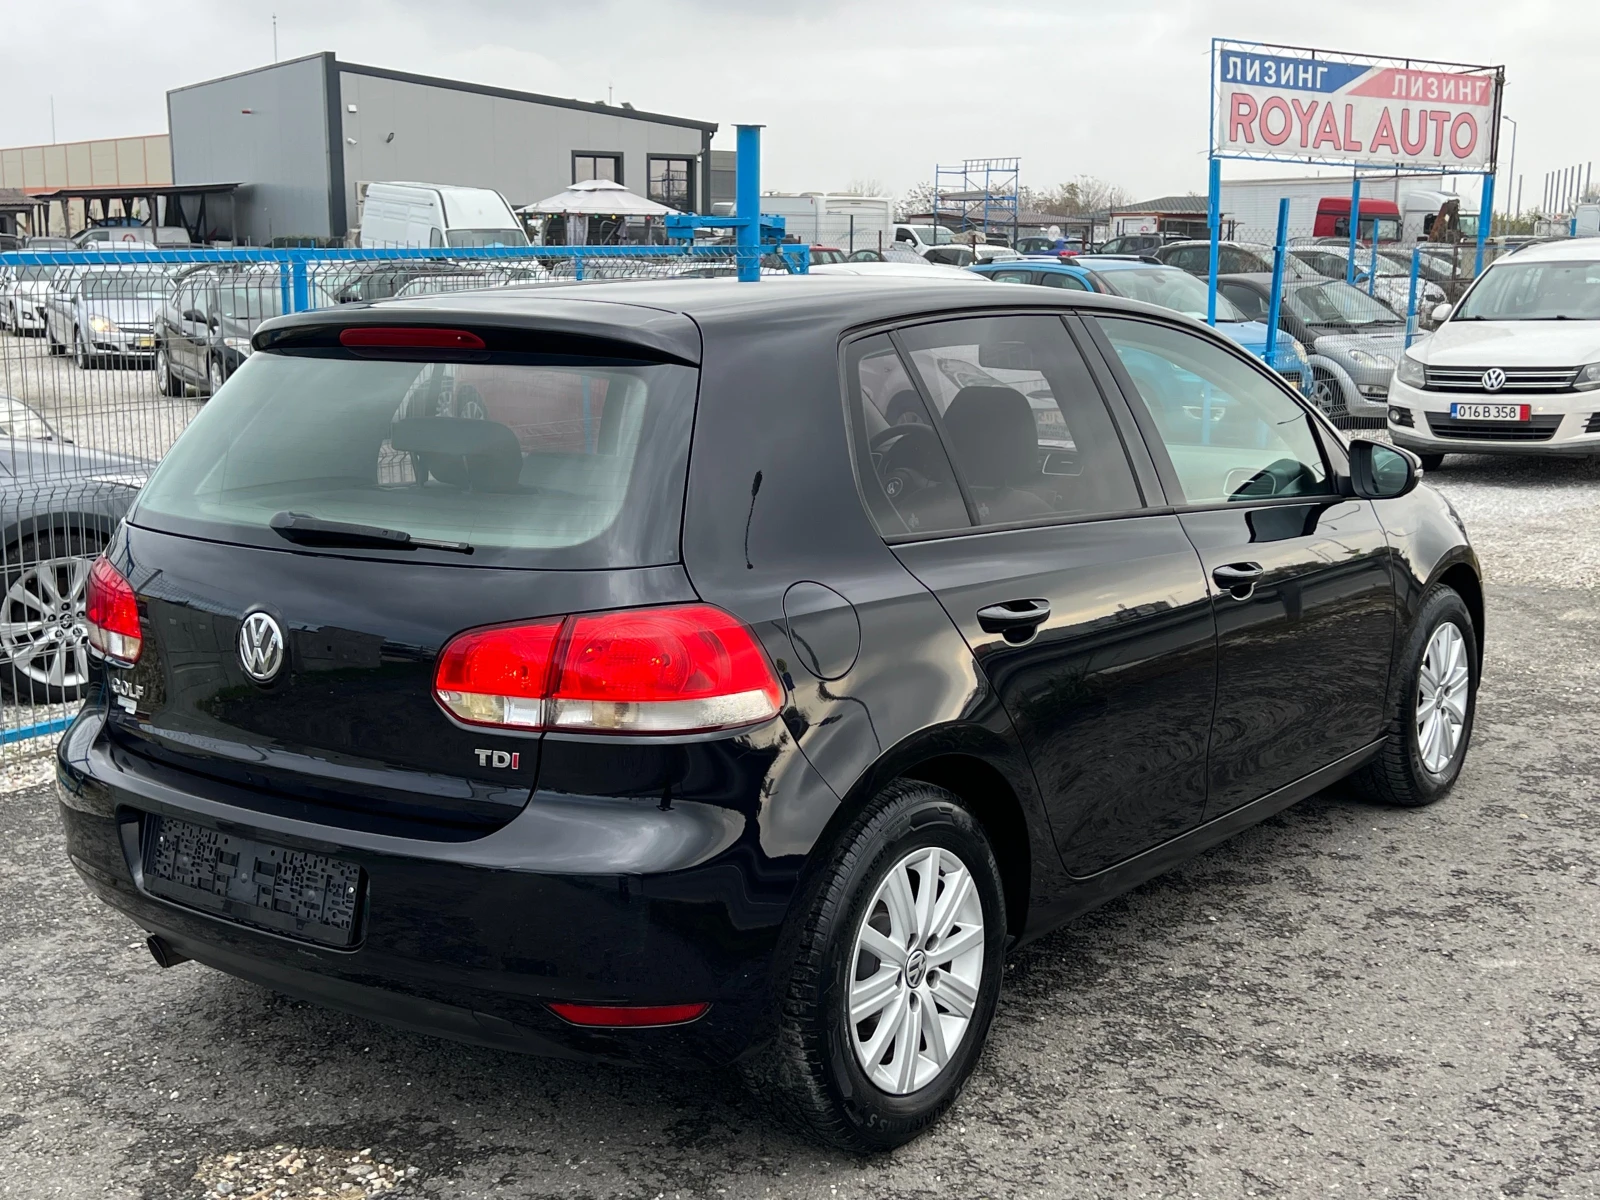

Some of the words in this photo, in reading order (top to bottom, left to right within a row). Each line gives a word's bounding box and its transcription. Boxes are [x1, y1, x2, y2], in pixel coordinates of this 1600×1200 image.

[1226, 56, 1329, 89] ЛИЗИНГ
[1391, 74, 1486, 103] ЛИЗИНГ
[1229, 92, 1363, 152] ROYAL
[1369, 106, 1479, 160] AUTO
[112, 677, 144, 700] GOLF
[474, 748, 520, 770] TDI
